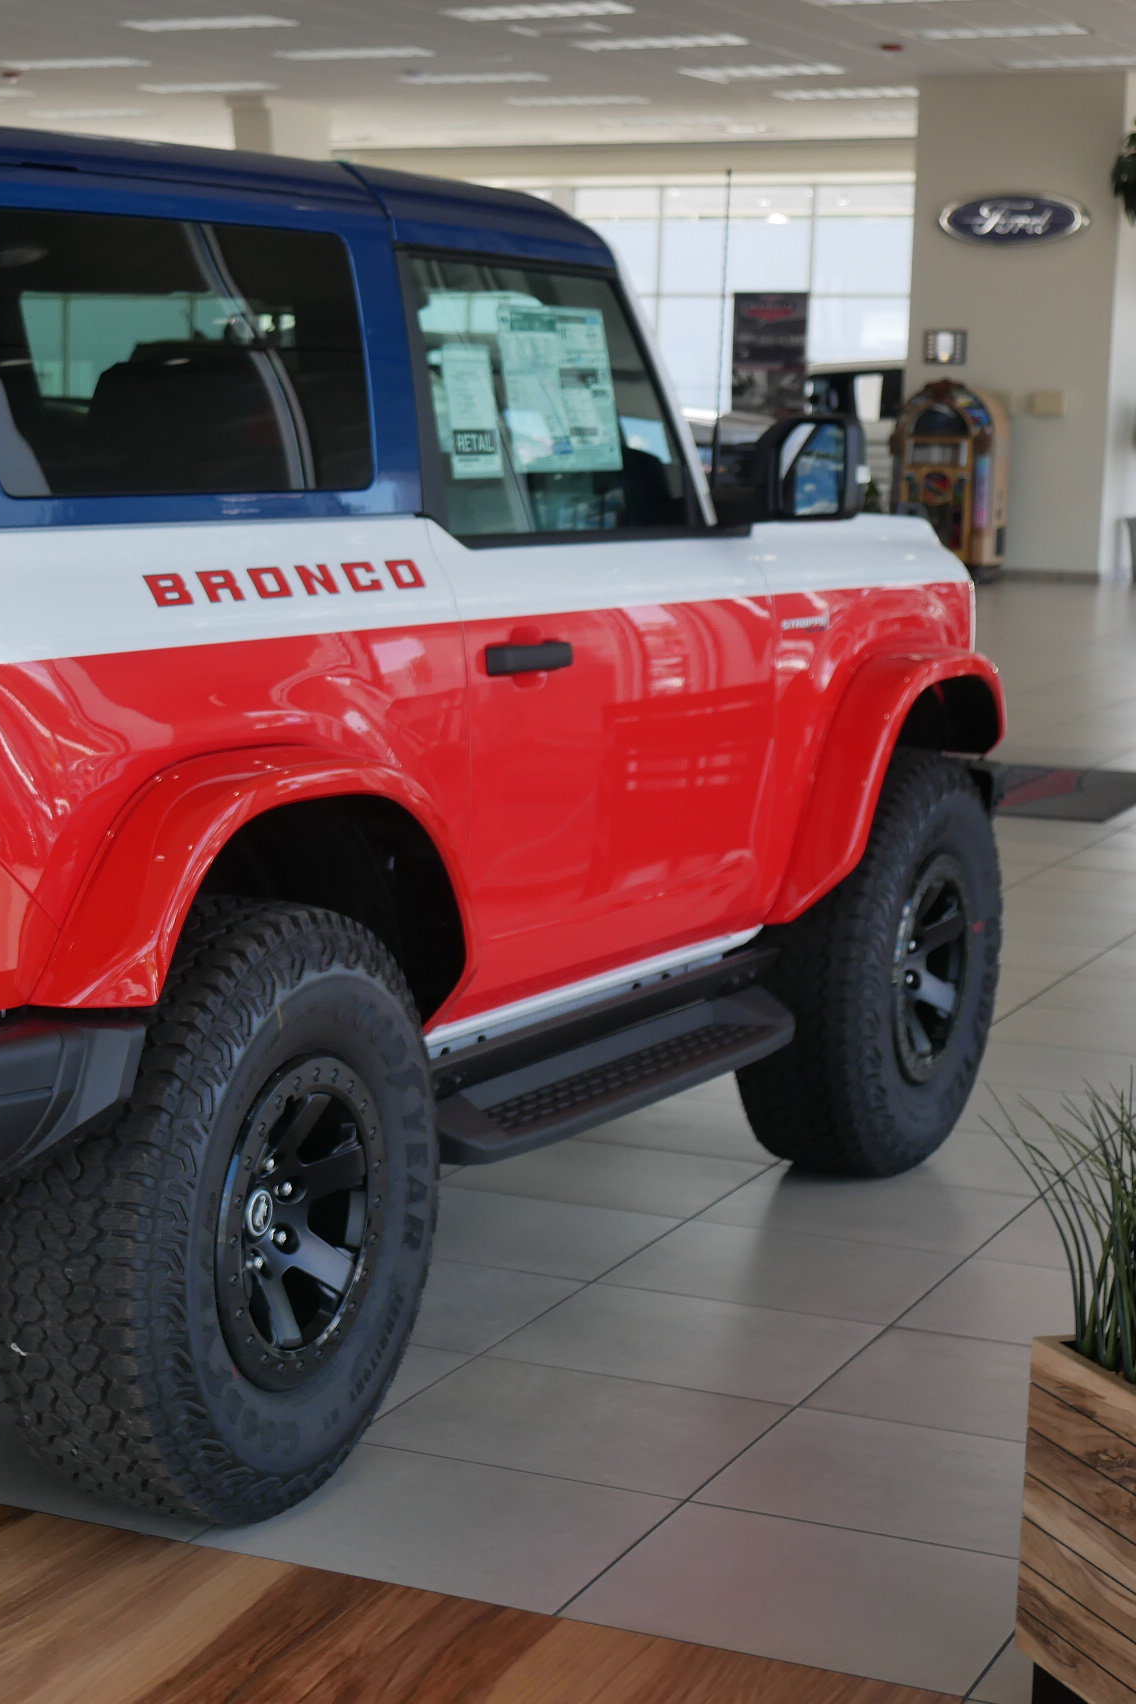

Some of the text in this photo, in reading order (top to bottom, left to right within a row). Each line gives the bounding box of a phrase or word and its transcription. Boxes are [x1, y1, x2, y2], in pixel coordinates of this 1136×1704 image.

[967, 201, 1053, 236] Ford
[457, 432, 495, 453] RETAIL
[143, 559, 427, 607] BRONCO
